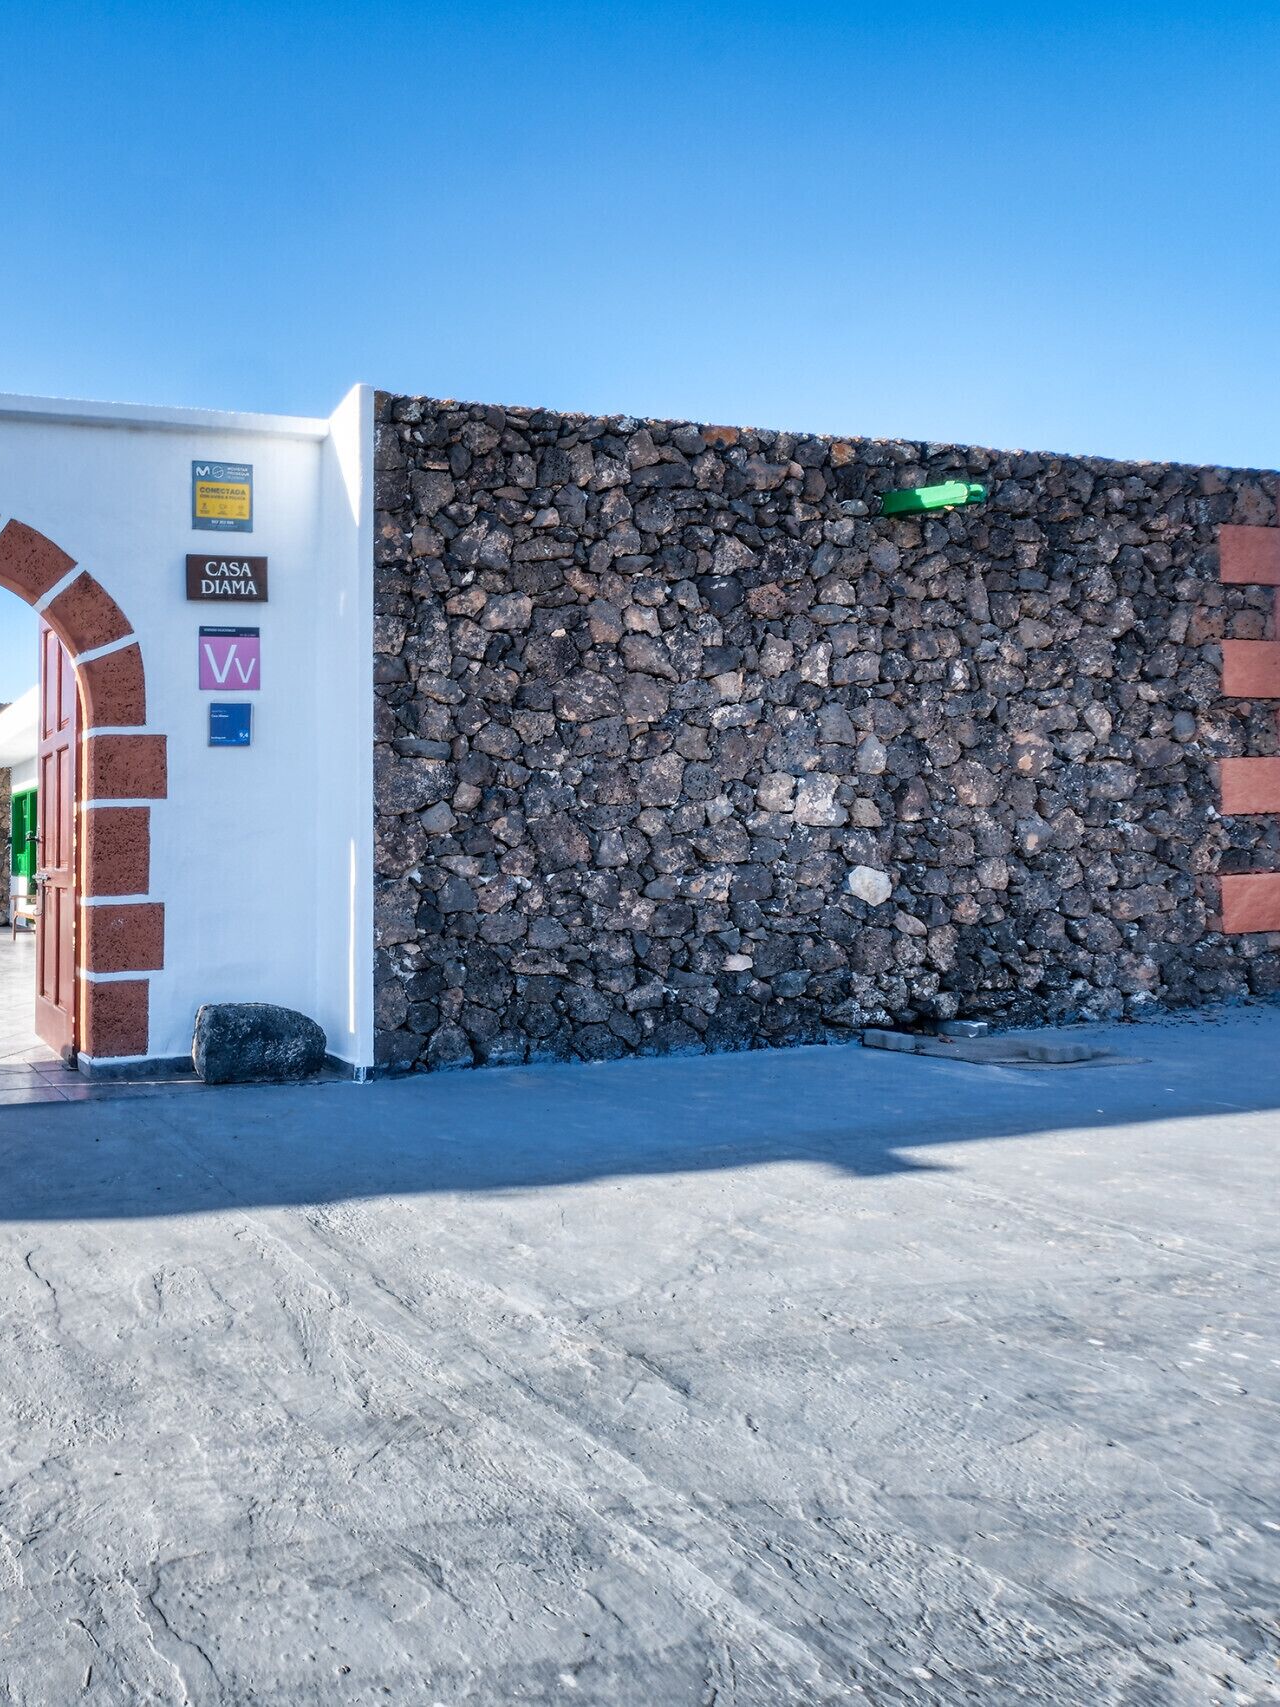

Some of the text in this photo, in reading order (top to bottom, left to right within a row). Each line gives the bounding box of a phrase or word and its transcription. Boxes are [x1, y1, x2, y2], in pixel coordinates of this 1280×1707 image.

[200, 487, 247, 495] CONECTADA
[205, 561, 252, 577] CASA
[201, 579, 258, 595] DIAMA
